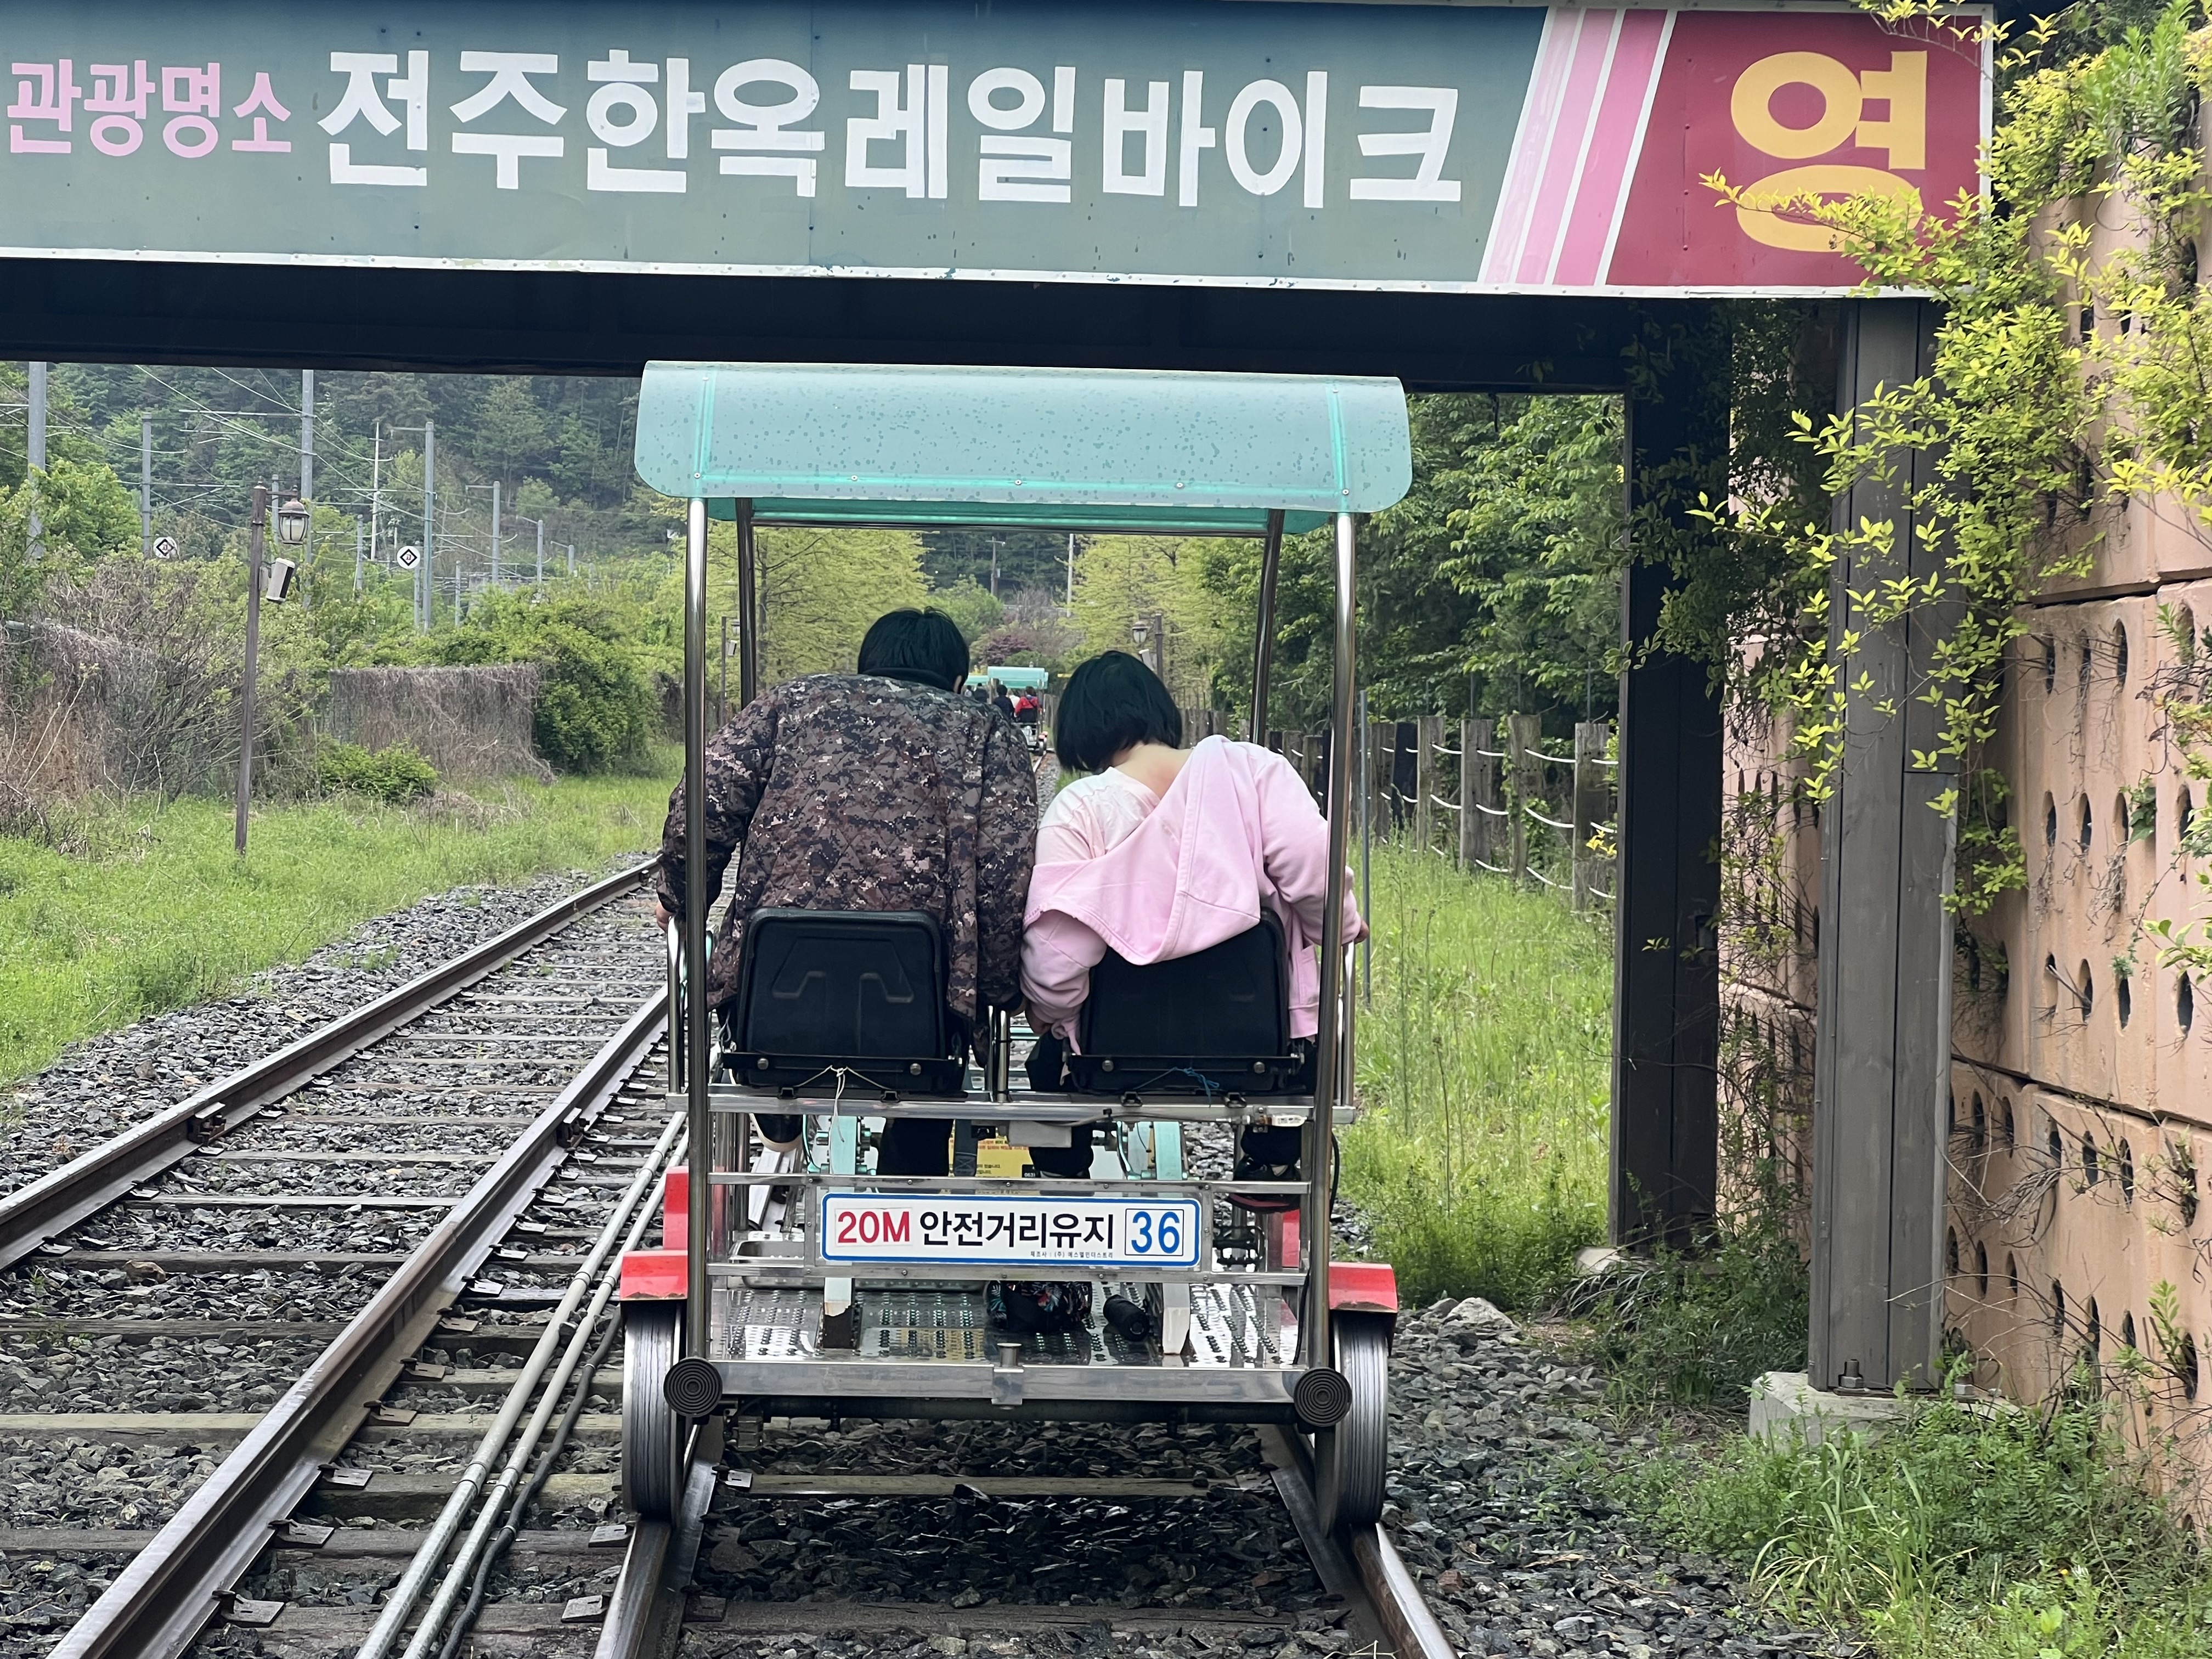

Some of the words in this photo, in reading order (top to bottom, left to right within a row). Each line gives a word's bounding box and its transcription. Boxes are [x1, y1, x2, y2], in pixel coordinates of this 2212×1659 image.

[7, 58, 291, 158] 관광명소
[317, 49, 1462, 208] 전주한옥레일바이크
[1731, 50, 1927, 252] 영
[837, 1211, 910, 1243] 20M
[920, 1211, 1113, 1249] 안전거리유지
[1131, 1211, 1180, 1254] 36
